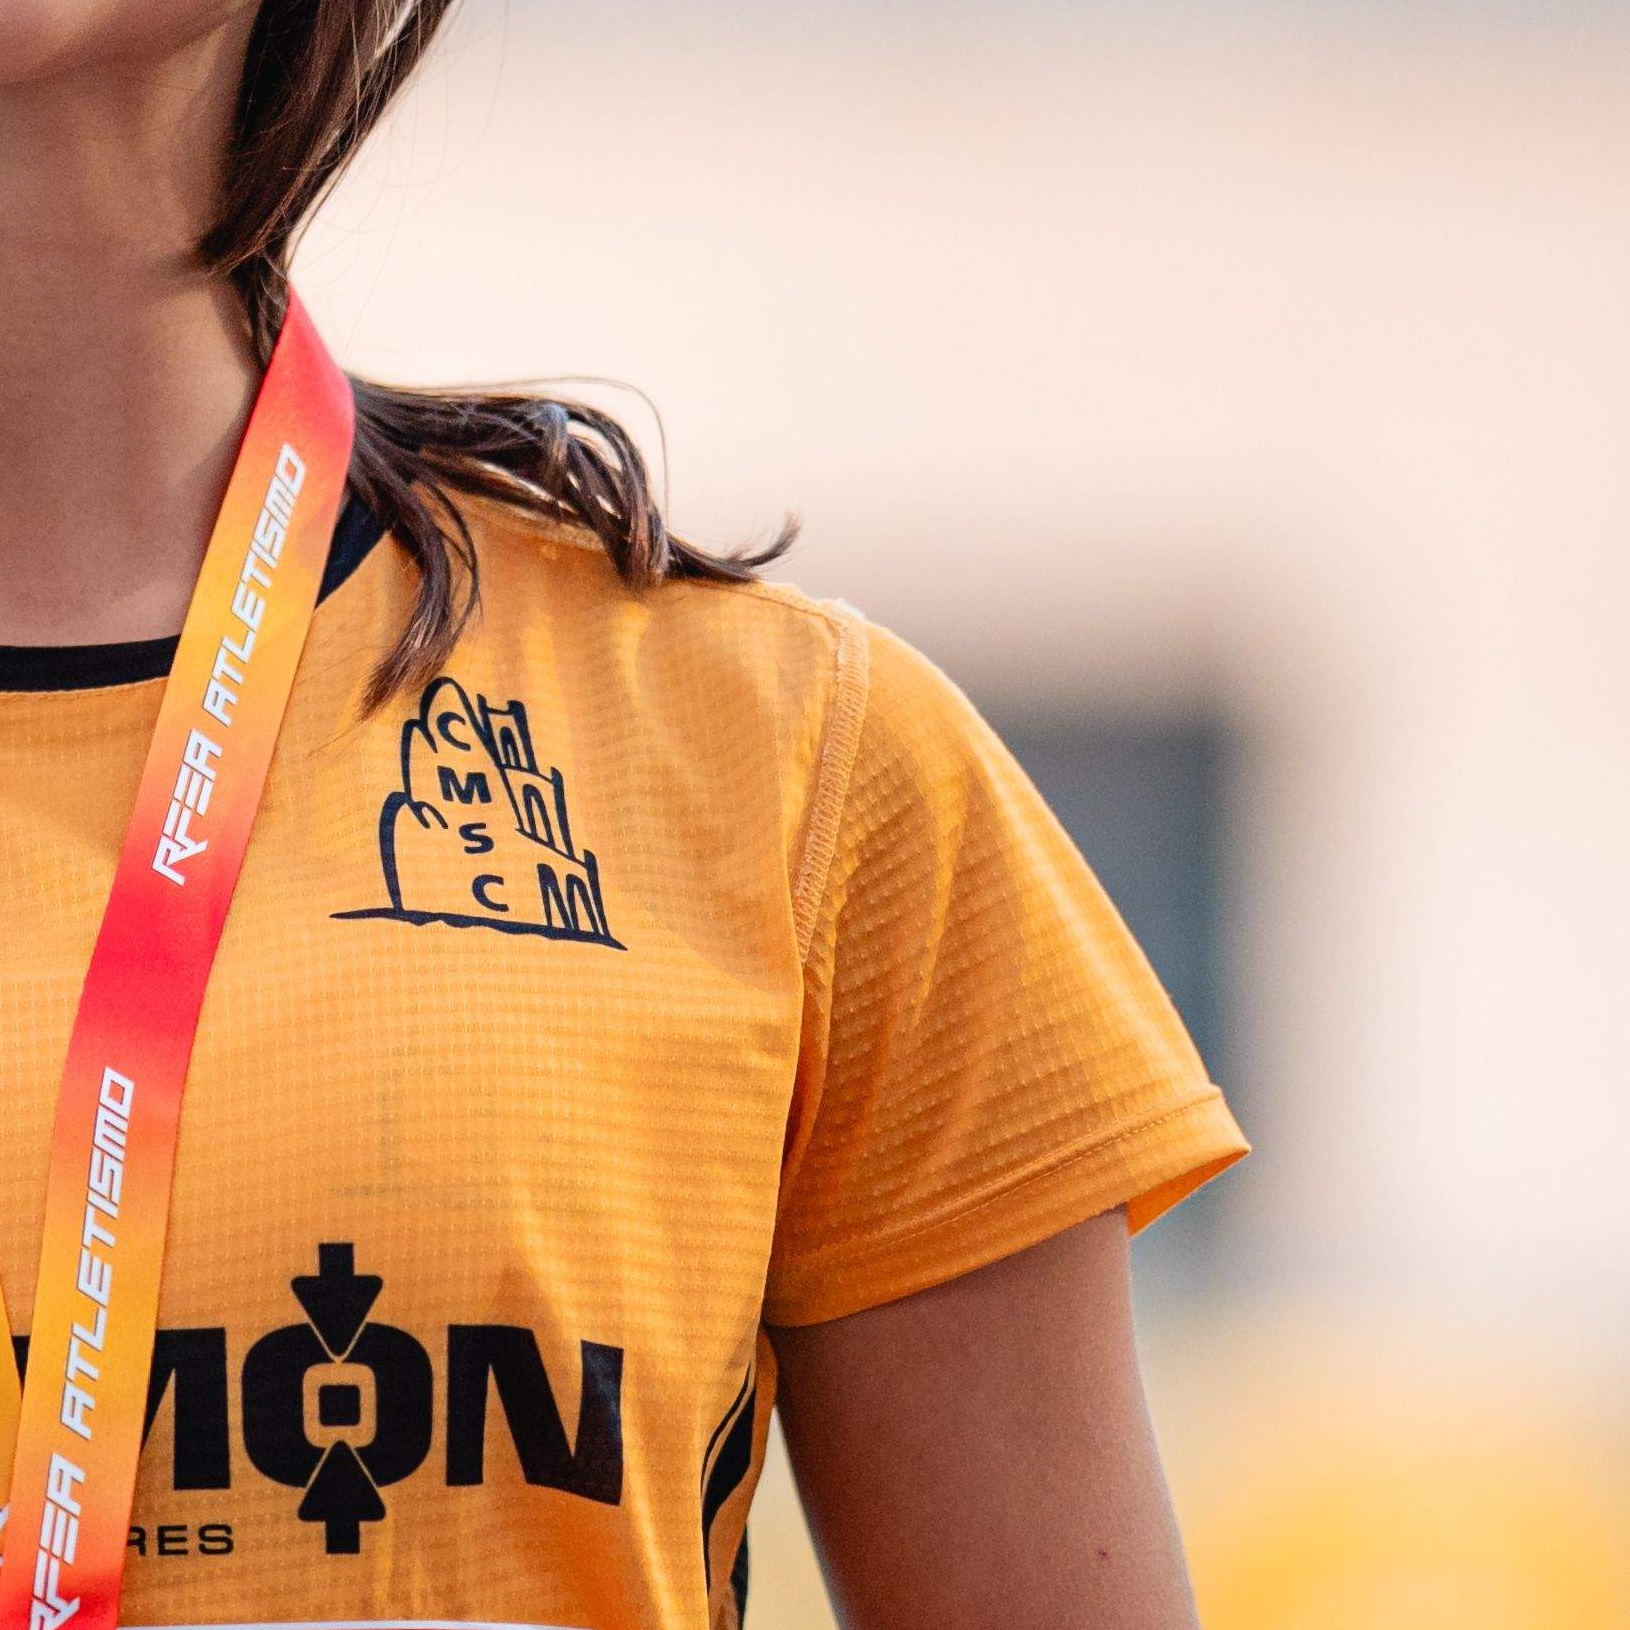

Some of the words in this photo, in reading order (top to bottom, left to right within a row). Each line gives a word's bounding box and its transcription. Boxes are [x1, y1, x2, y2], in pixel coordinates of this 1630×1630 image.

[151, 728, 223, 887] RFEA
[202, 444, 307, 727] ATLETISMO
[59, 1066, 135, 1441] ATLETISMO
